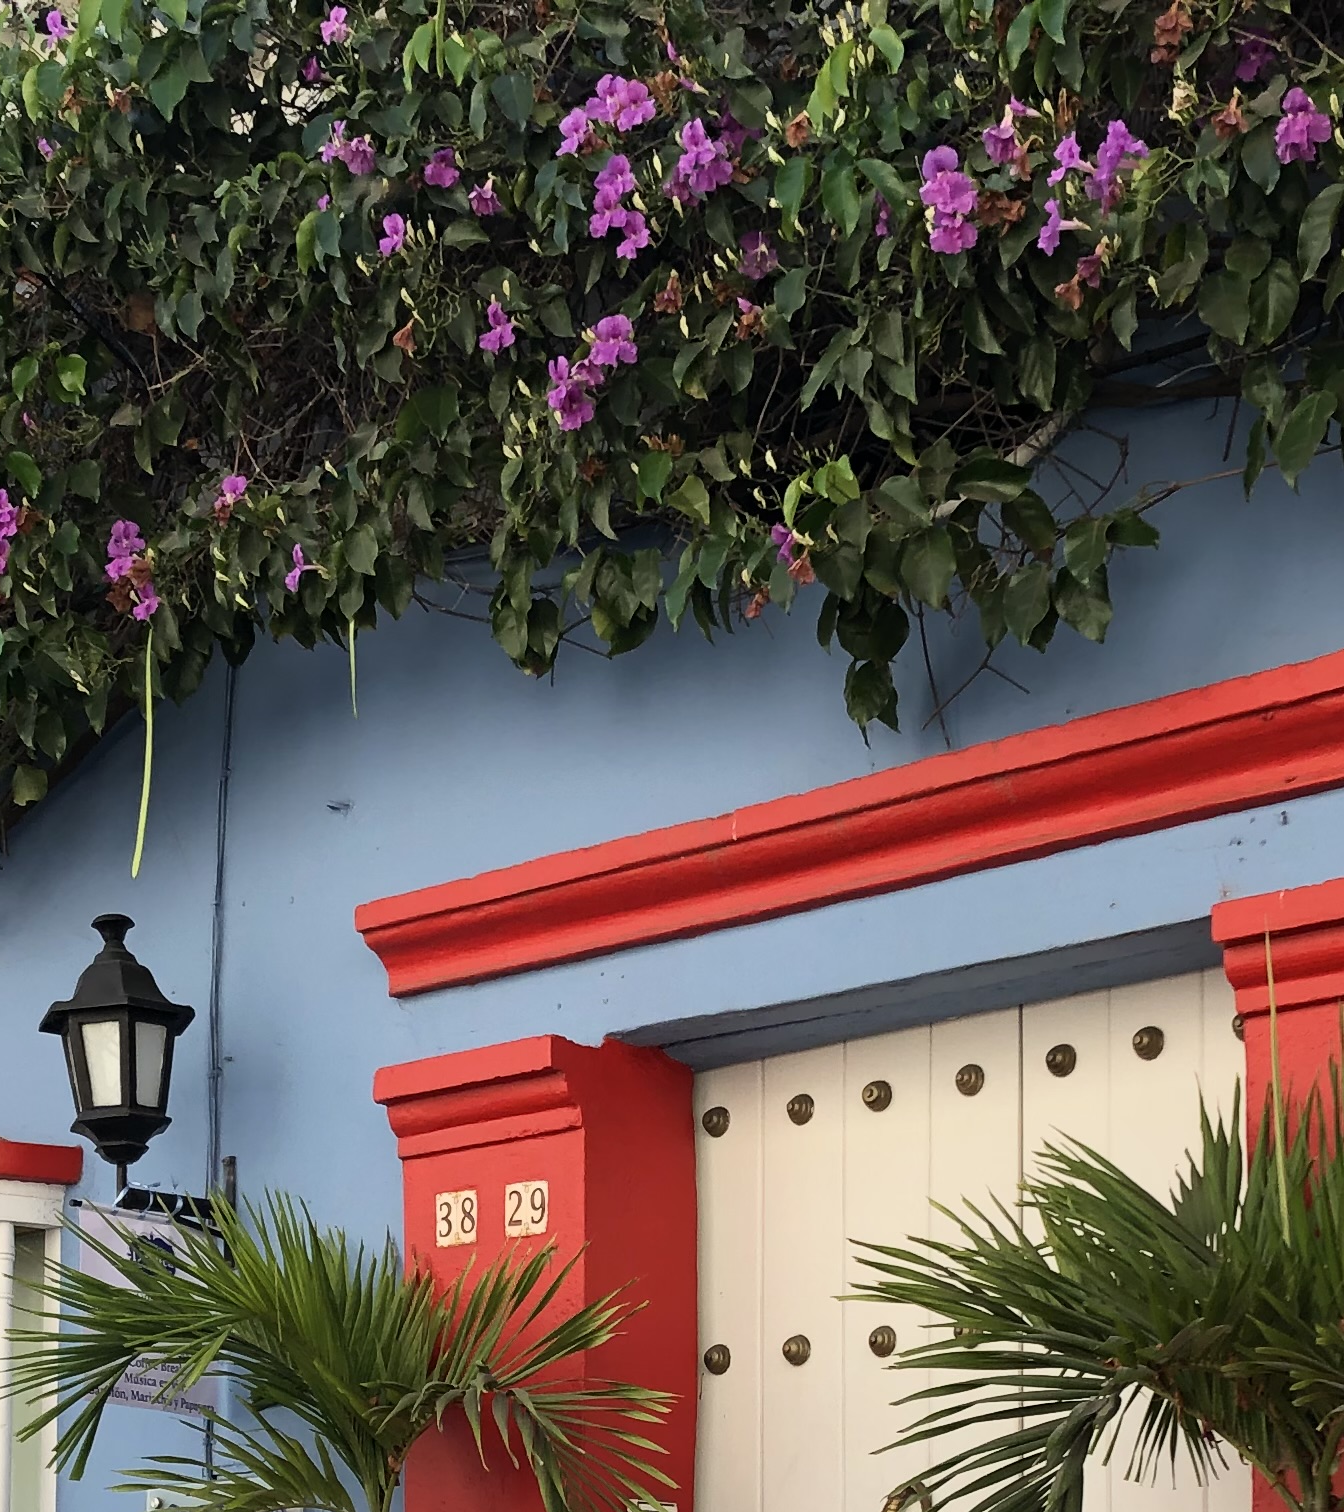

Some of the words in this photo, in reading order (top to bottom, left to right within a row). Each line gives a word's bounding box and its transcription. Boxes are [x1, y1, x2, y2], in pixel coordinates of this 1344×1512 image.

[439, 1196, 476, 1238] 38
[507, 1187, 546, 1227] 29
[124, 1372, 157, 1388] Música
